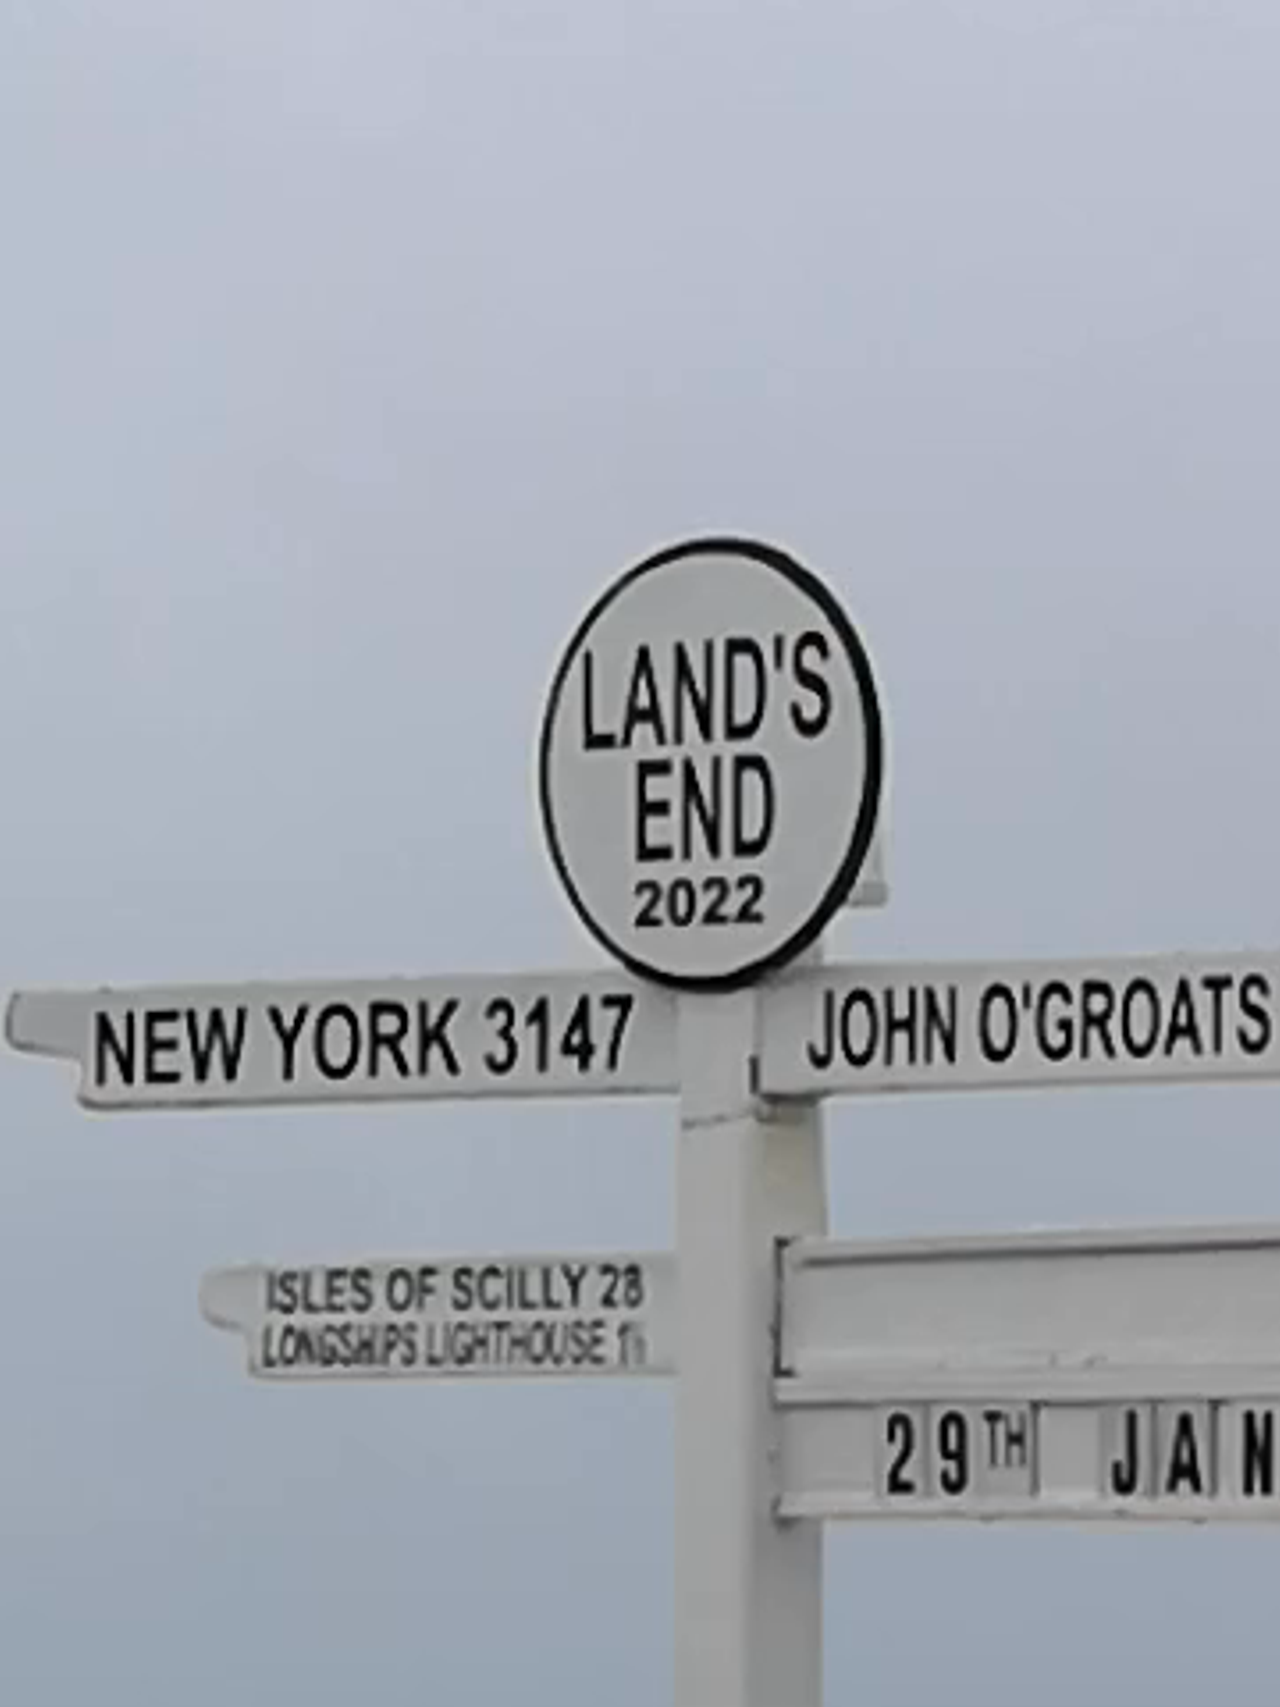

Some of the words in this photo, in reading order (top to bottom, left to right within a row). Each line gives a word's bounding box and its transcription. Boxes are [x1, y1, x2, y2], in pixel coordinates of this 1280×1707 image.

[580, 630, 829, 750] LAND'S
[633, 753, 776, 864] END
[633, 873, 766, 930] 2022
[94, 1004, 248, 1088] NEW
[265, 995, 462, 1083] YORK
[483, 992, 636, 1077] 3147
[805, 984, 958, 1071] JOHN
[977, 971, 1272, 1064] O'GROATS
[265, 1266, 374, 1315] ISLES
[385, 1265, 440, 1313] OF
[451, 1263, 588, 1312] SCILLY
[262, 1321, 418, 1369] LONGSHIPS
[425, 1319, 606, 1367] LIGHTHOUSE
